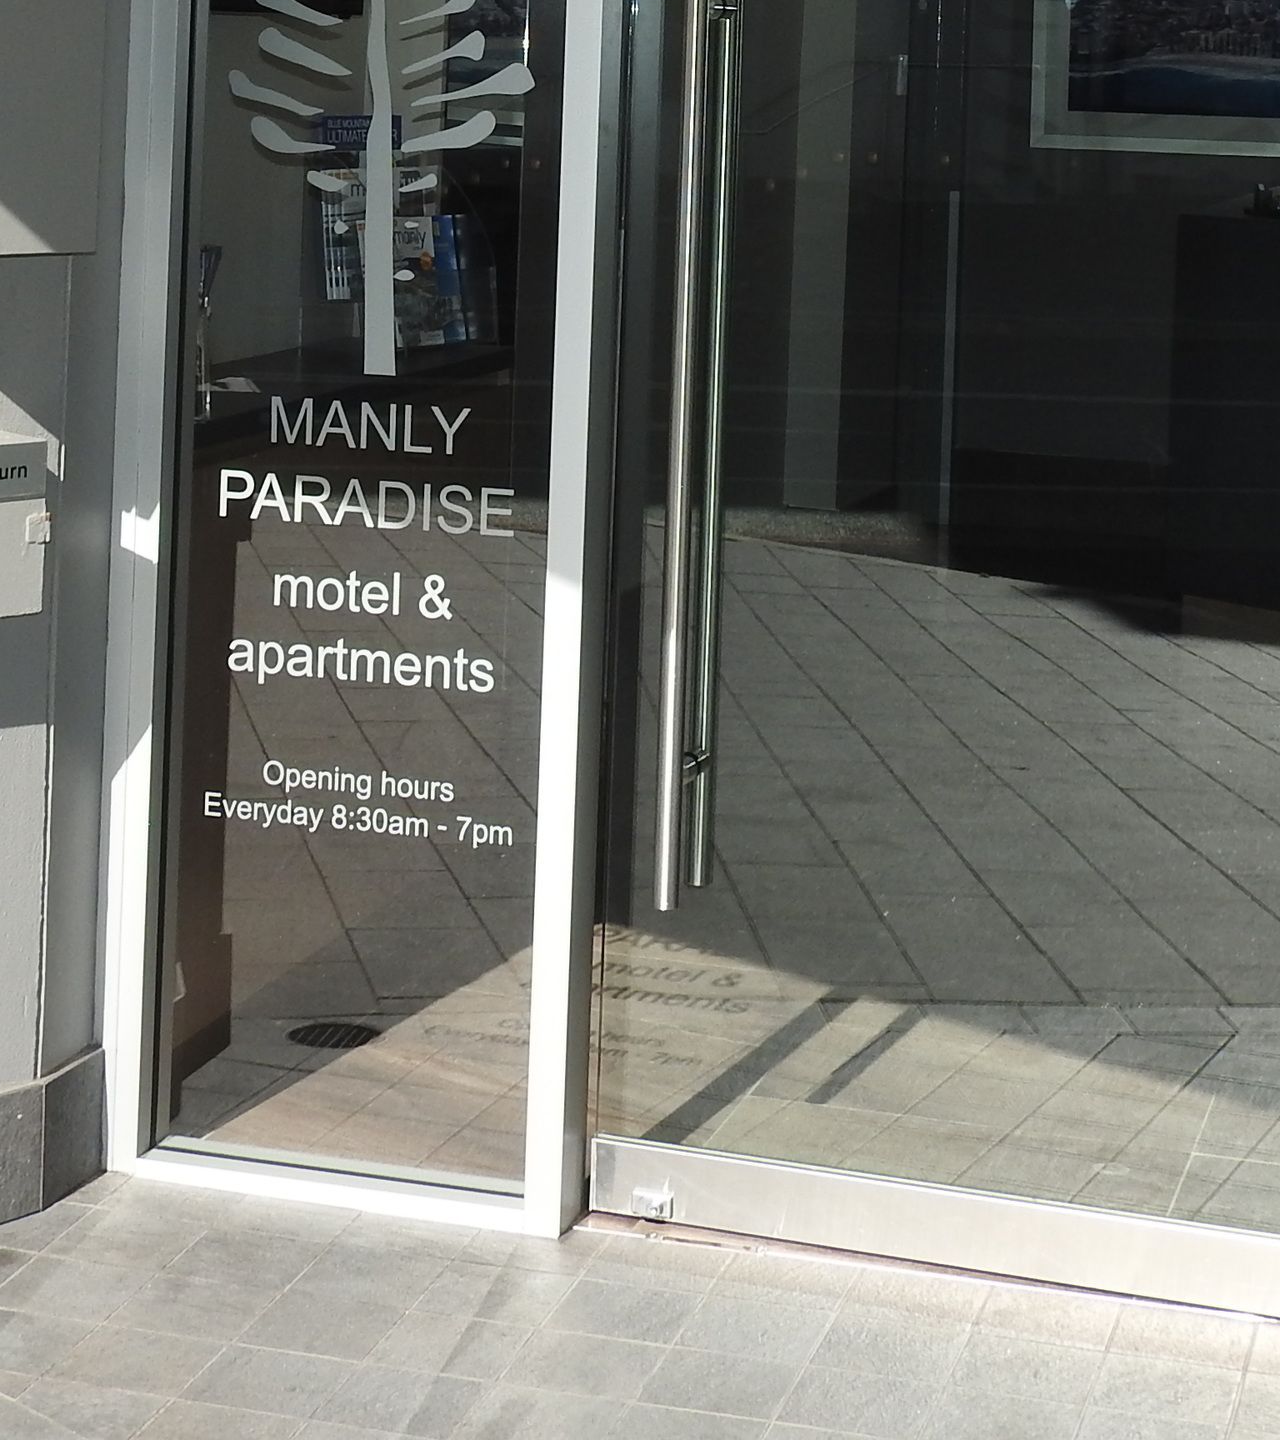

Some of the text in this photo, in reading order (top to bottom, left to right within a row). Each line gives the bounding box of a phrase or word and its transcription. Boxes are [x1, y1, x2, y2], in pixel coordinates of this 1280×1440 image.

[270, 396, 472, 455] MANLY
[219, 468, 516, 538] PARADISE
[273, 570, 453, 621] motel &
[227, 637, 495, 694] apartments
[262, 759, 455, 803] Opening hours
[203, 791, 324, 833] Everyday
[331, 809, 429, 840] 8:30am
[456, 816, 513, 849] 7pm
